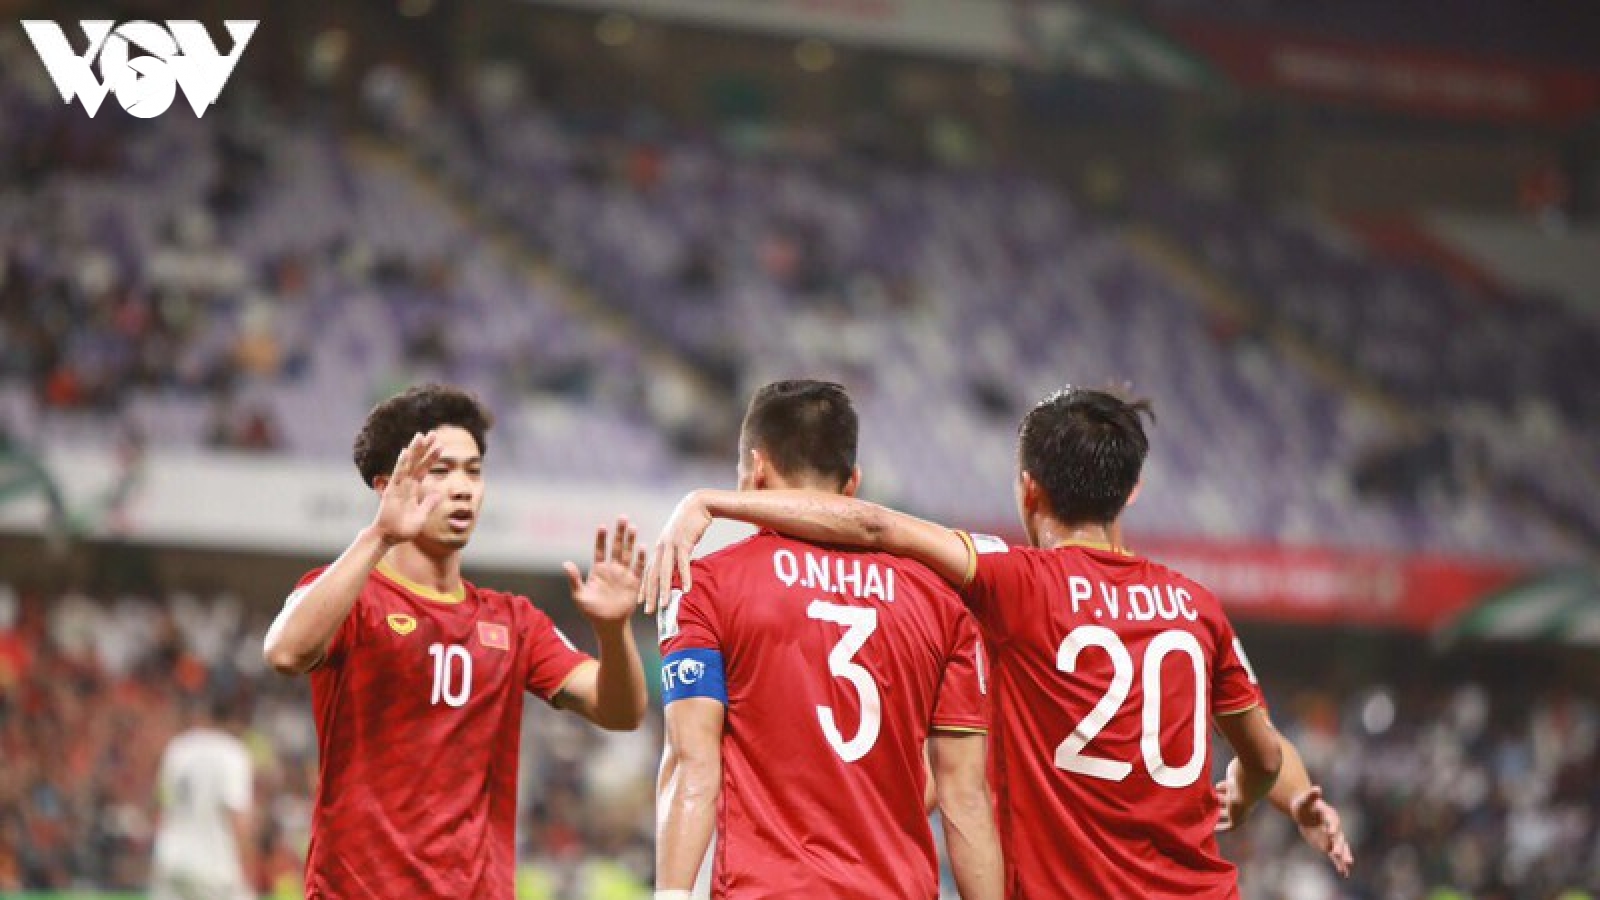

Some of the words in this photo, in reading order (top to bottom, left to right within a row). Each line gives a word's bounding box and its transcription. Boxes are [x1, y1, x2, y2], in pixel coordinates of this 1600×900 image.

[773, 548, 895, 603] Q.N.HAI
[1068, 575, 1199, 622] P.V.DUC
[428, 642, 473, 707] 10
[806, 598, 882, 763] 3
[1054, 624, 1207, 788] 20
